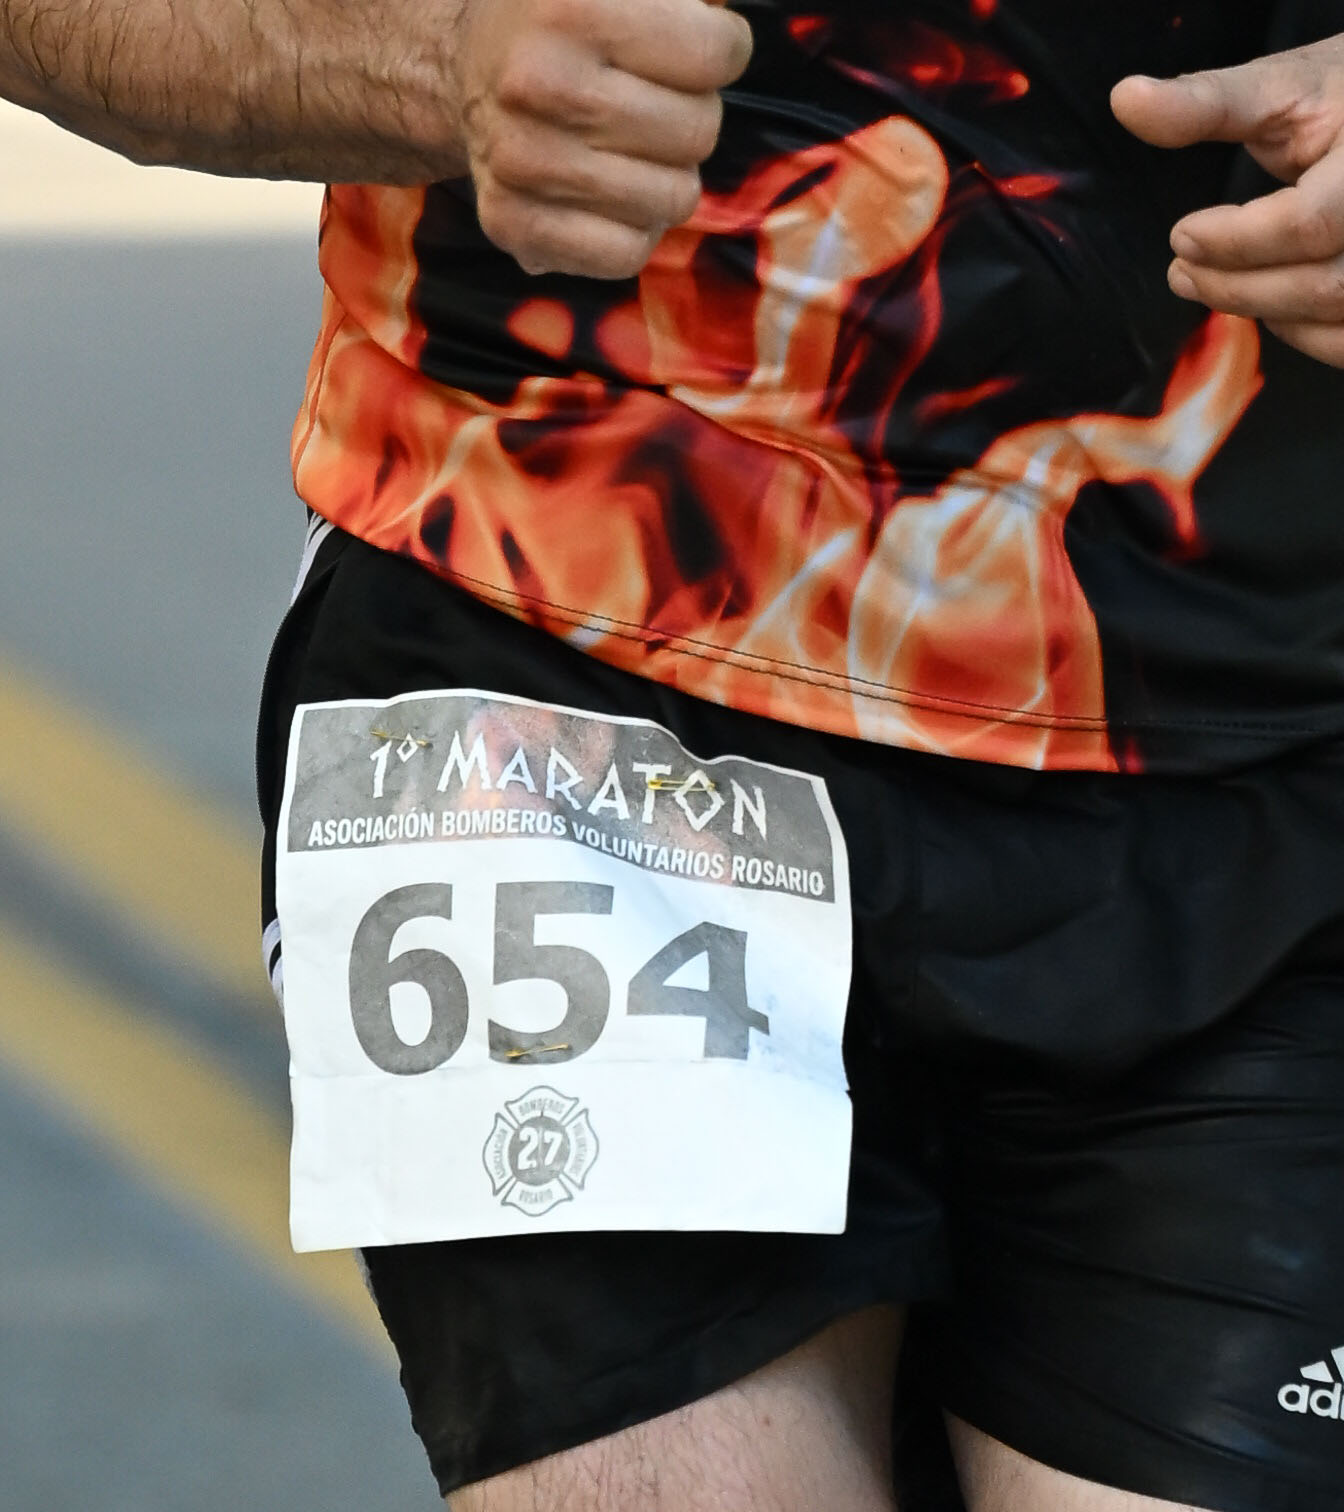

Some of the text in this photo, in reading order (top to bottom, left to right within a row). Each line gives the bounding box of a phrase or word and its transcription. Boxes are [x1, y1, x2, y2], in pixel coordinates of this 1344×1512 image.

[308, 807, 826, 897] ASOCIACIÓN BOMBEROS VOLUNTARIOS ROSARIO
[348, 881, 770, 1076] 654
[517, 1126, 564, 1171] 27
